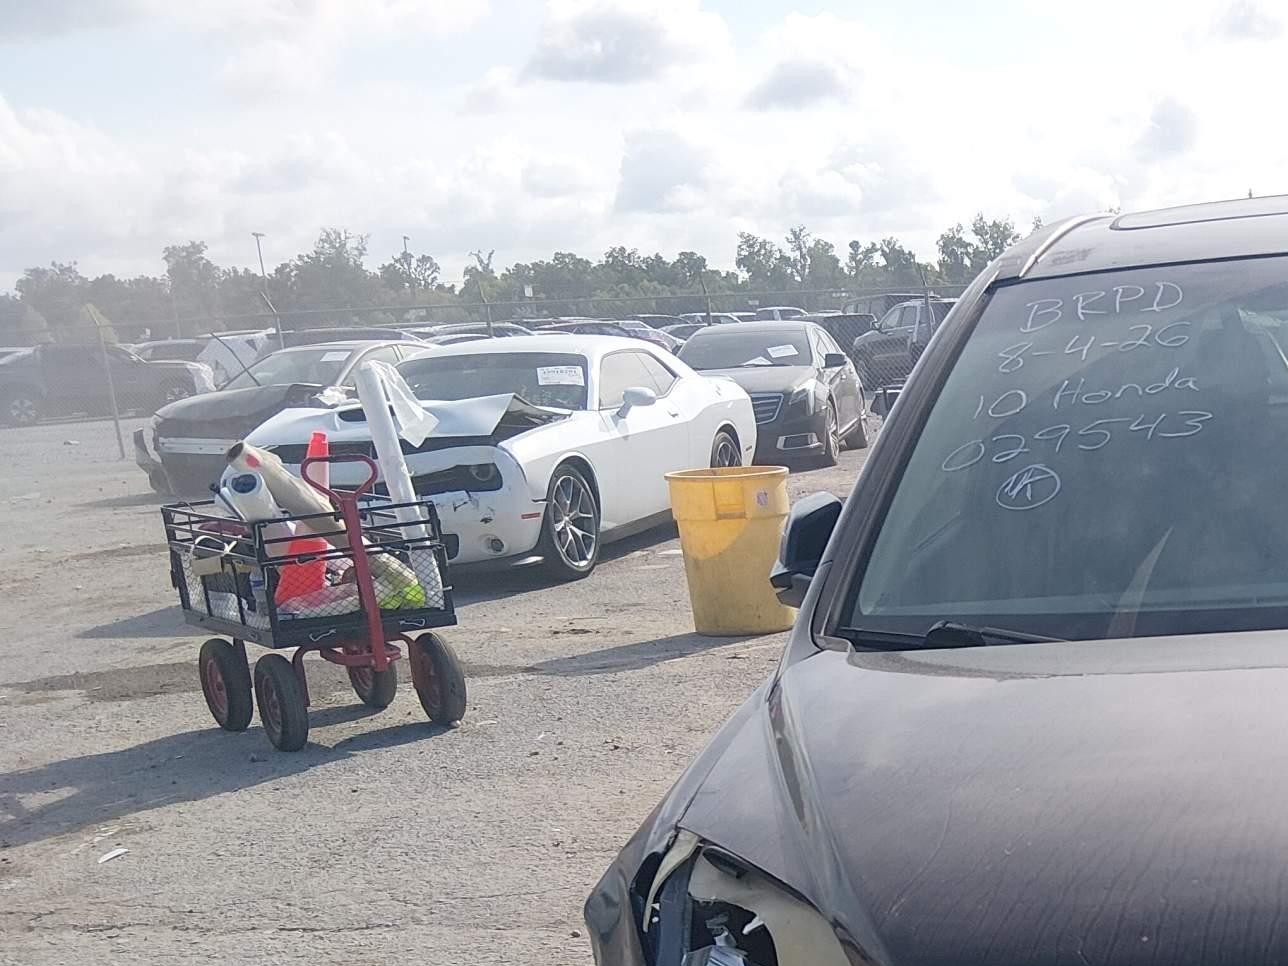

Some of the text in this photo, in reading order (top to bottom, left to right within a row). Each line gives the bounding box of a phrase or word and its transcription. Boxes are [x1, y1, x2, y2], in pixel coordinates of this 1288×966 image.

[1020, 282, 1183, 333] BRPD
[997, 322, 1192, 372] 8-4-26
[973, 367, 1200, 419] 10 Honda
[942, 411, 1214, 471] 029543
